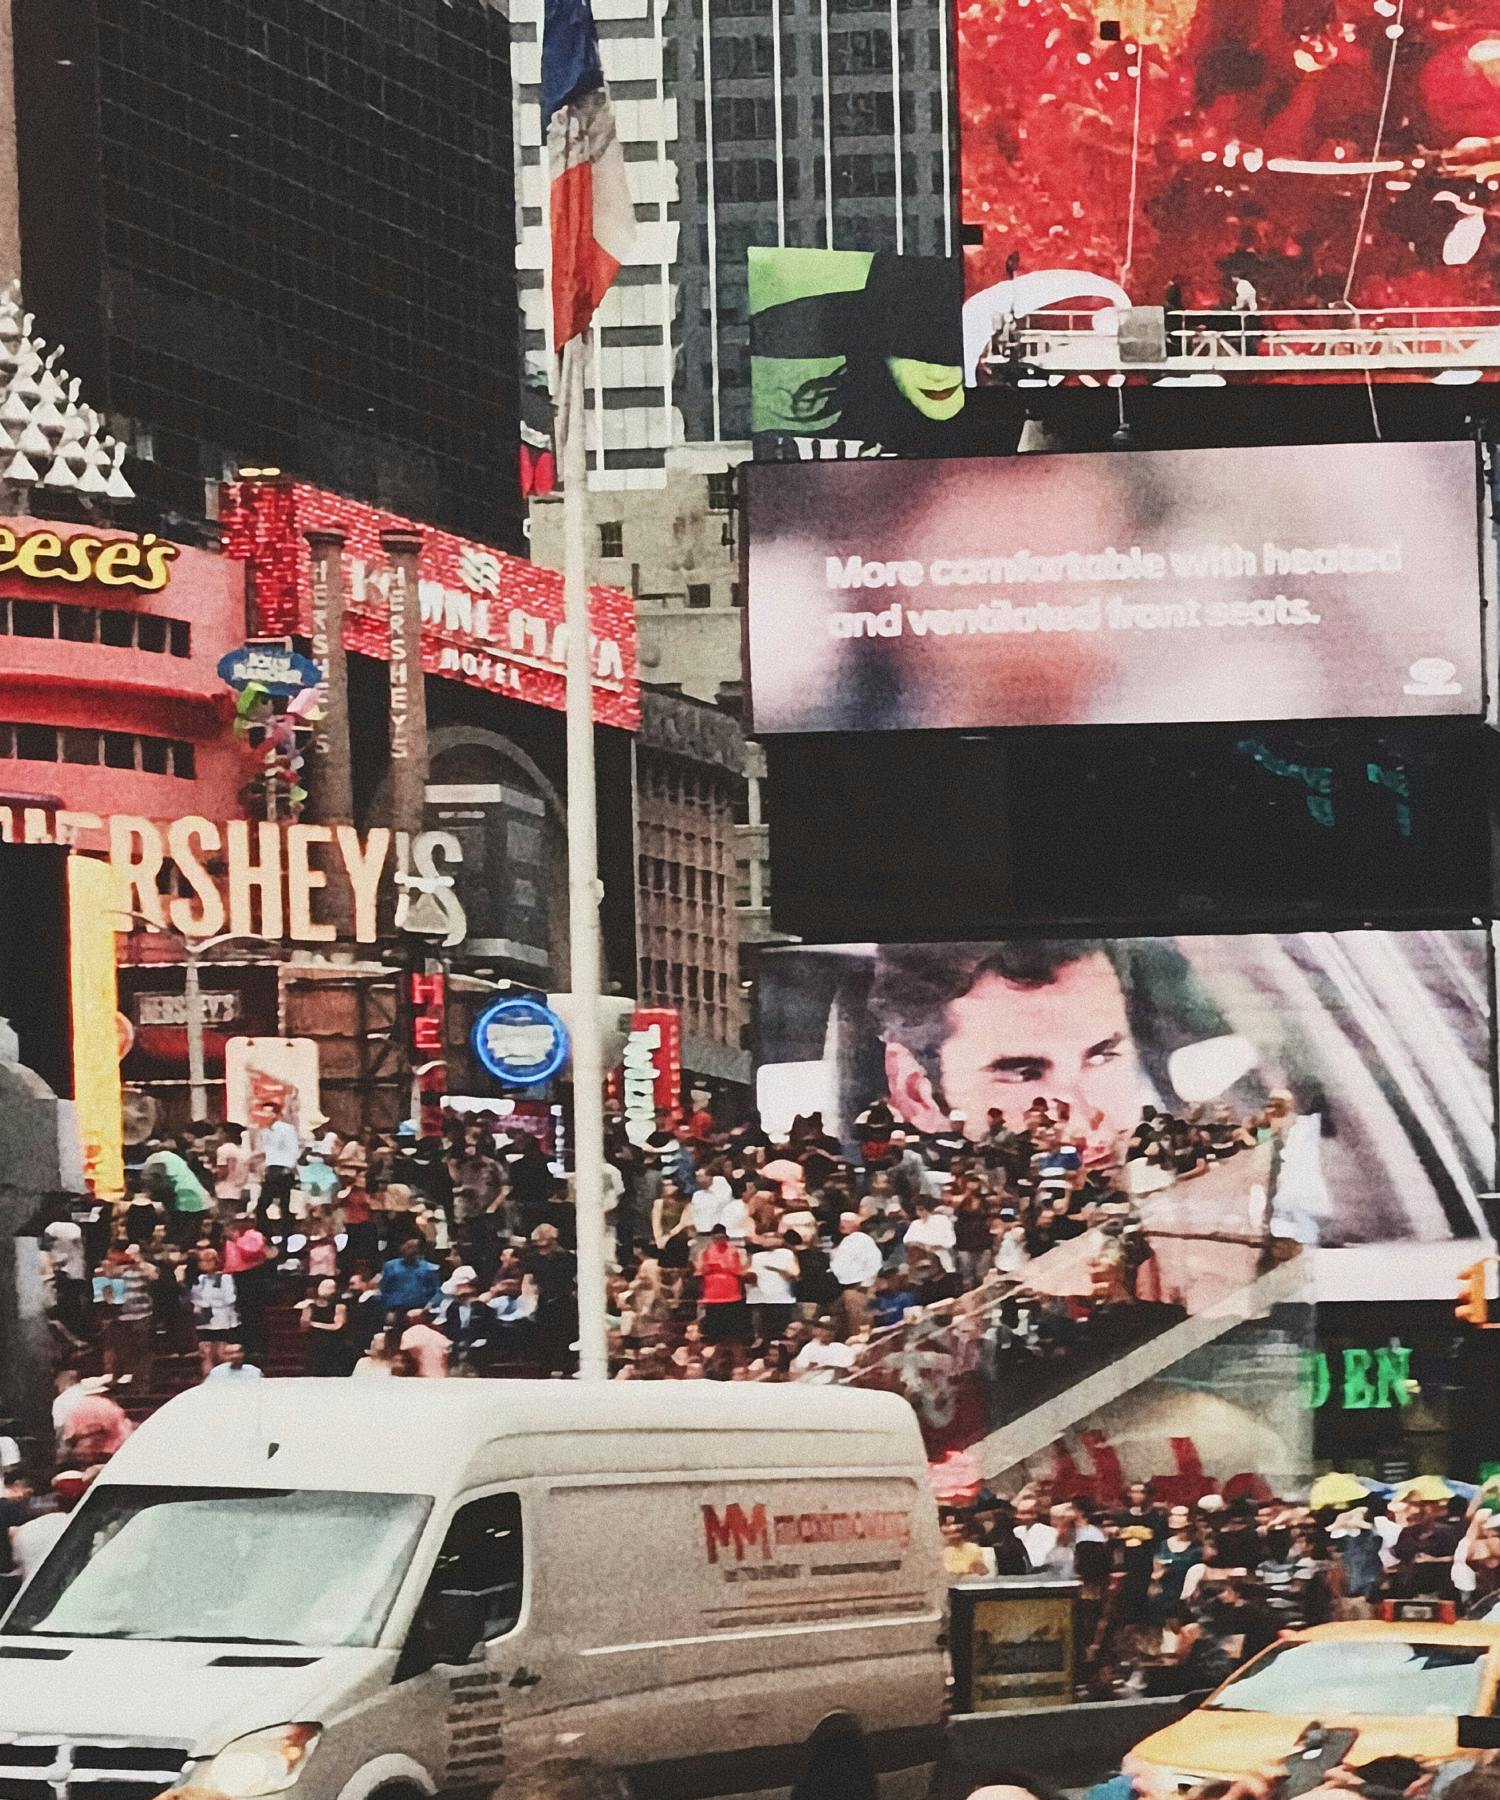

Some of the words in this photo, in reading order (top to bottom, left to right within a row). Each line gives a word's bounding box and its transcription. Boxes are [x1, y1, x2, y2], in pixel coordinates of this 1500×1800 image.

[826, 555, 924, 589] More
[930, 546, 1163, 586] comfortable
[1169, 542, 1257, 579] with
[1263, 542, 1402, 576] heated
[828, 603, 903, 639] and
[907, 599, 1100, 637] ventilated
[1106, 597, 1201, 631] front
[1204, 594, 1322, 628] seats.
[0, 808, 467, 946] RSHEY'S
